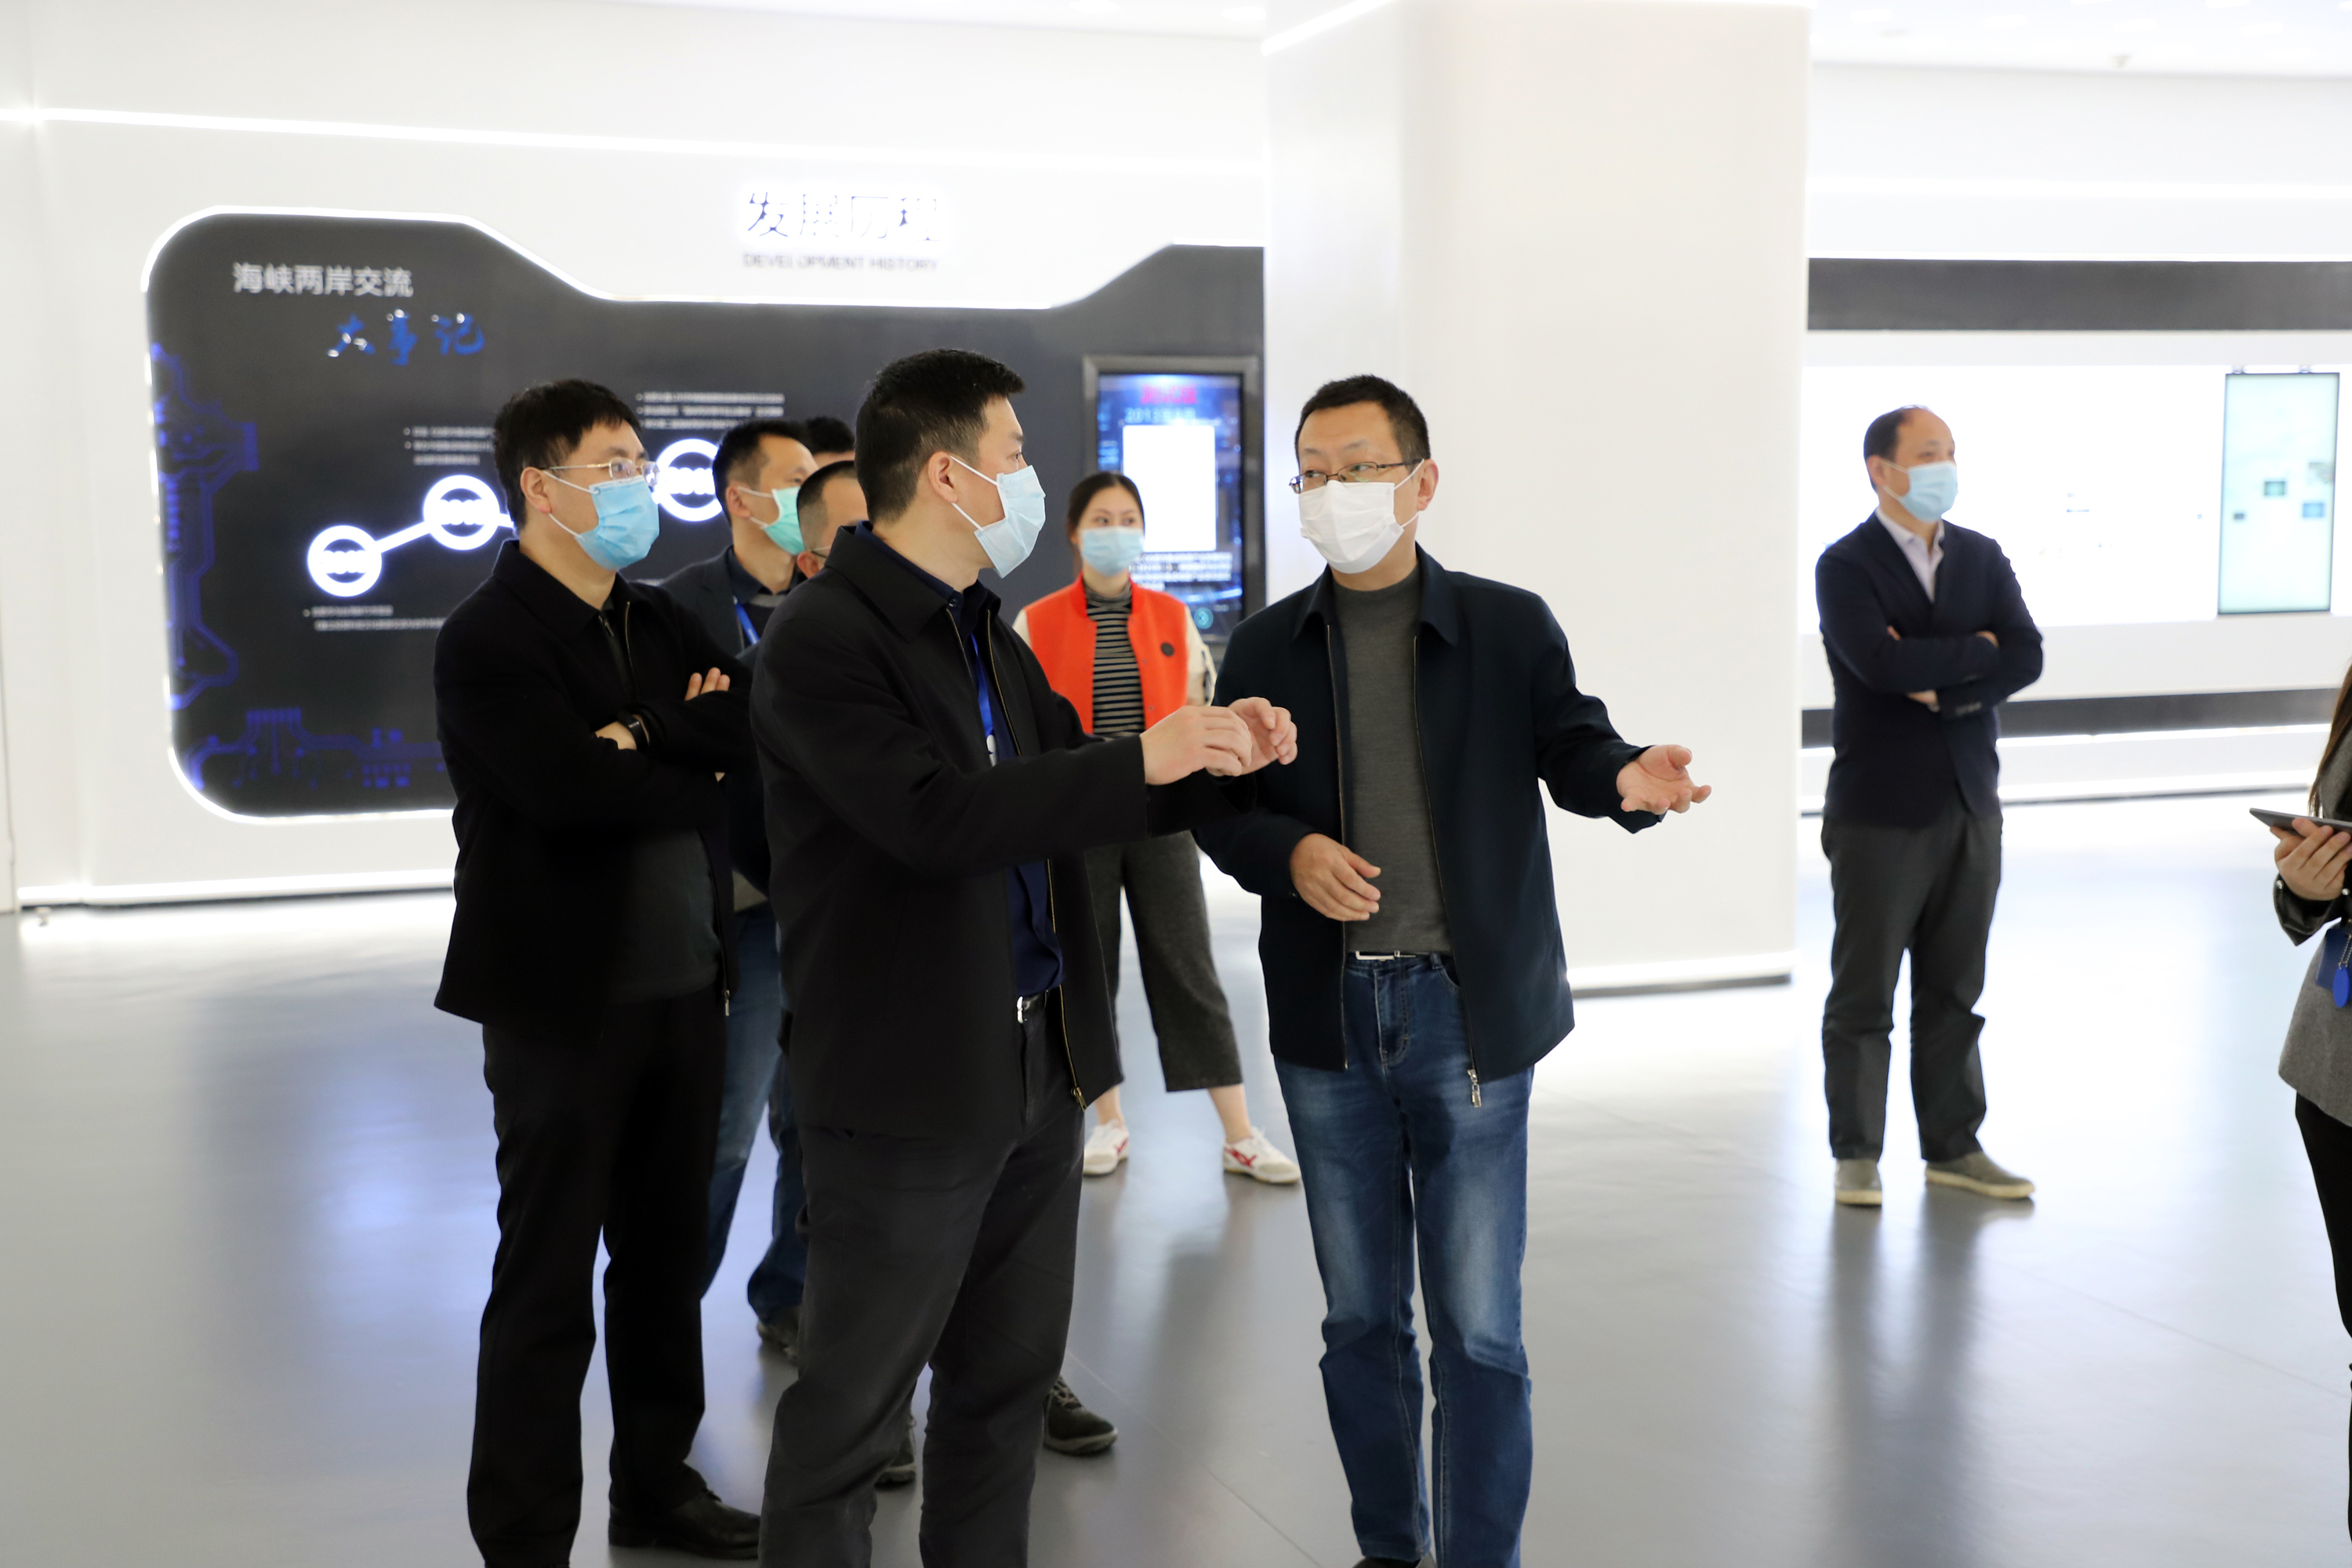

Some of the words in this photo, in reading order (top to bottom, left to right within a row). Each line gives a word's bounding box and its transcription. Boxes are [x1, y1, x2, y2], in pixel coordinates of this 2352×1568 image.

[234, 262, 413, 297] 海峡两岸交流
[742, 252, 864, 270] DEVELOPMENT
[869, 256, 940, 272] HISTORY
[328, 309, 485, 366] 大事记
